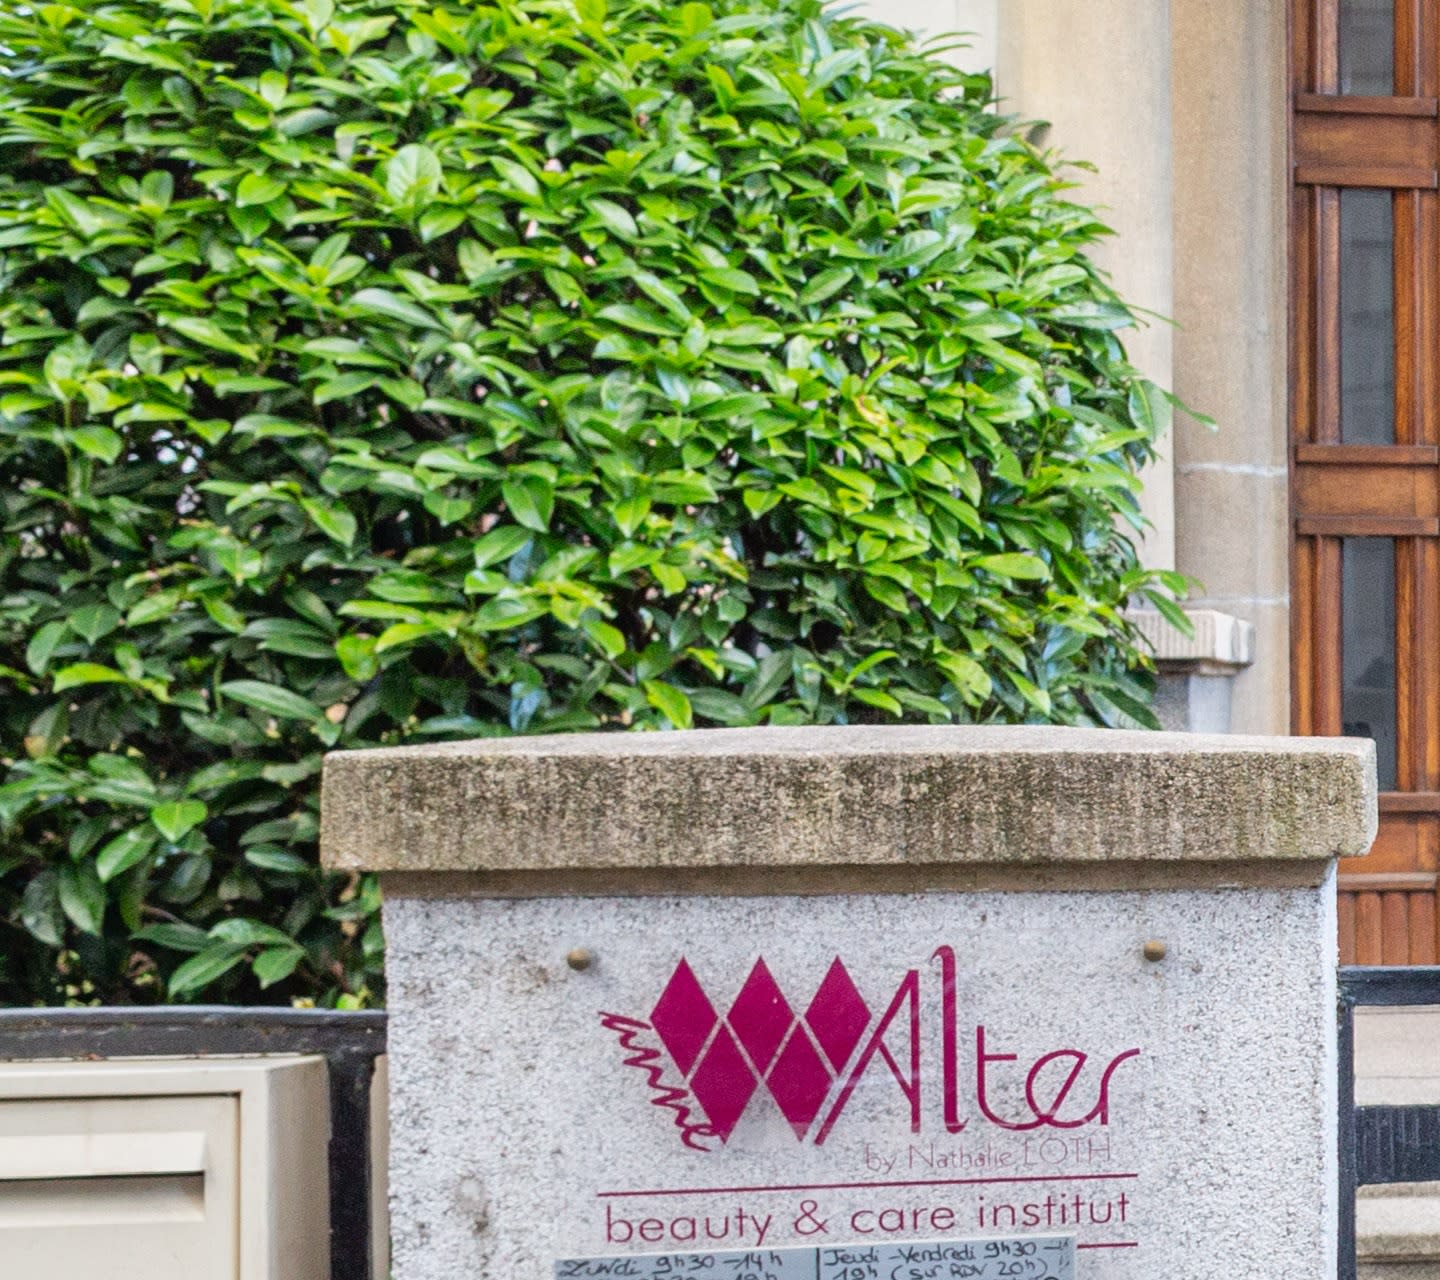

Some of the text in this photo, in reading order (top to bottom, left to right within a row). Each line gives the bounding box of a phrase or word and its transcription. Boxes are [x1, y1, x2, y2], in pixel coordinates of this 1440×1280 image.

[864, 1142, 896, 1174] by
[908, 1140, 1016, 1169] Nathalie
[606, 1192, 1131, 1246] beauty & care institut
[652, 1255, 715, 1274] 9h30
[824, 1248, 880, 1266] Jeudi
[984, 1241, 1036, 1259] 9h30
